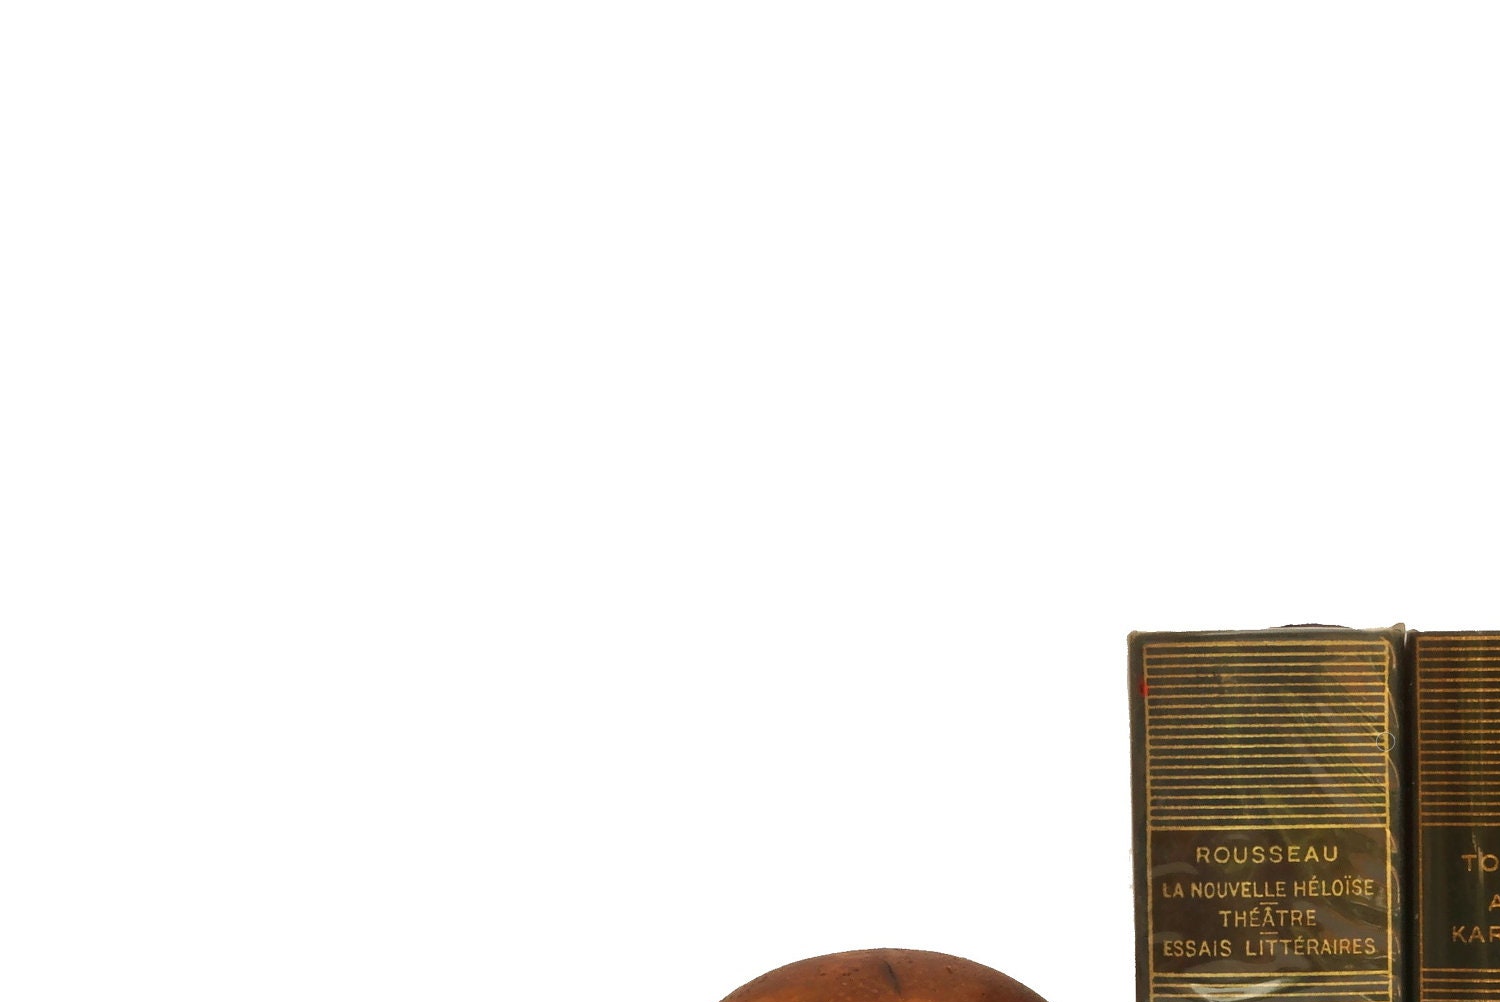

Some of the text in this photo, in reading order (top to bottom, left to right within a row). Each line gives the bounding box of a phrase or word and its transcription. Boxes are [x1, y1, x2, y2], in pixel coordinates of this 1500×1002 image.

[1196, 845, 1339, 864] ROUSSEAU
[1162, 875, 1374, 899] LA NOUVELLE HÉLOÏSE
[1219, 906, 1317, 928] THÉÂTRE
[1163, 936, 1376, 958] ESSAIS LITTÉRAIRES
